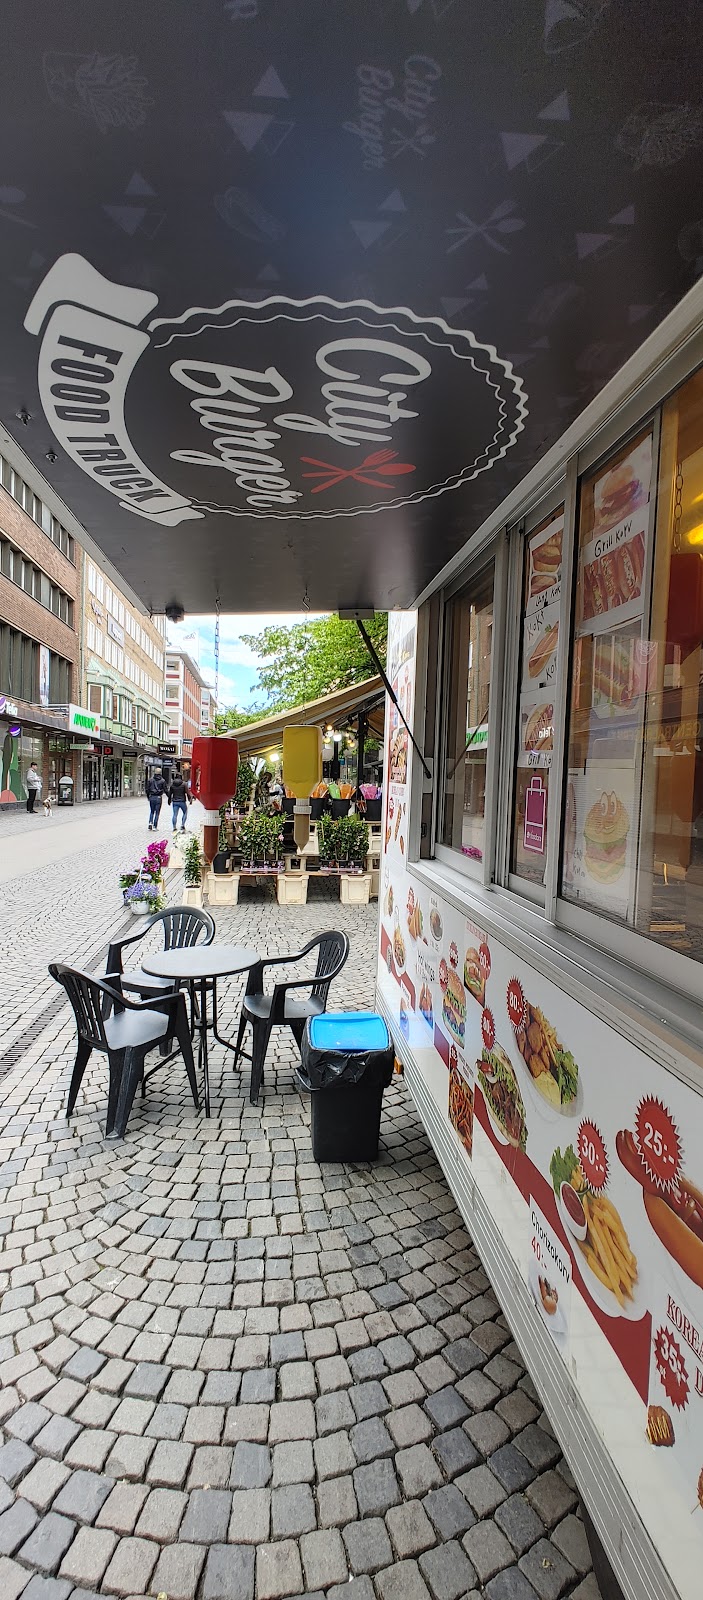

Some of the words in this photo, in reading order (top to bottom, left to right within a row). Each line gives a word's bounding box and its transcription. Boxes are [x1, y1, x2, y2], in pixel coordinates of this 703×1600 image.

[50, 335, 123, 423] FOOD
[273, 337, 432, 446] City
[169, 359, 303, 507] Burger
[67, 433, 172, 503] TRUCK
[594, 537, 613, 558] Grill
[544, 753, 552, 767] Ko
[581, 1134, 604, 1172] 30:-
[643, 1121, 675, 1165] 25:-
